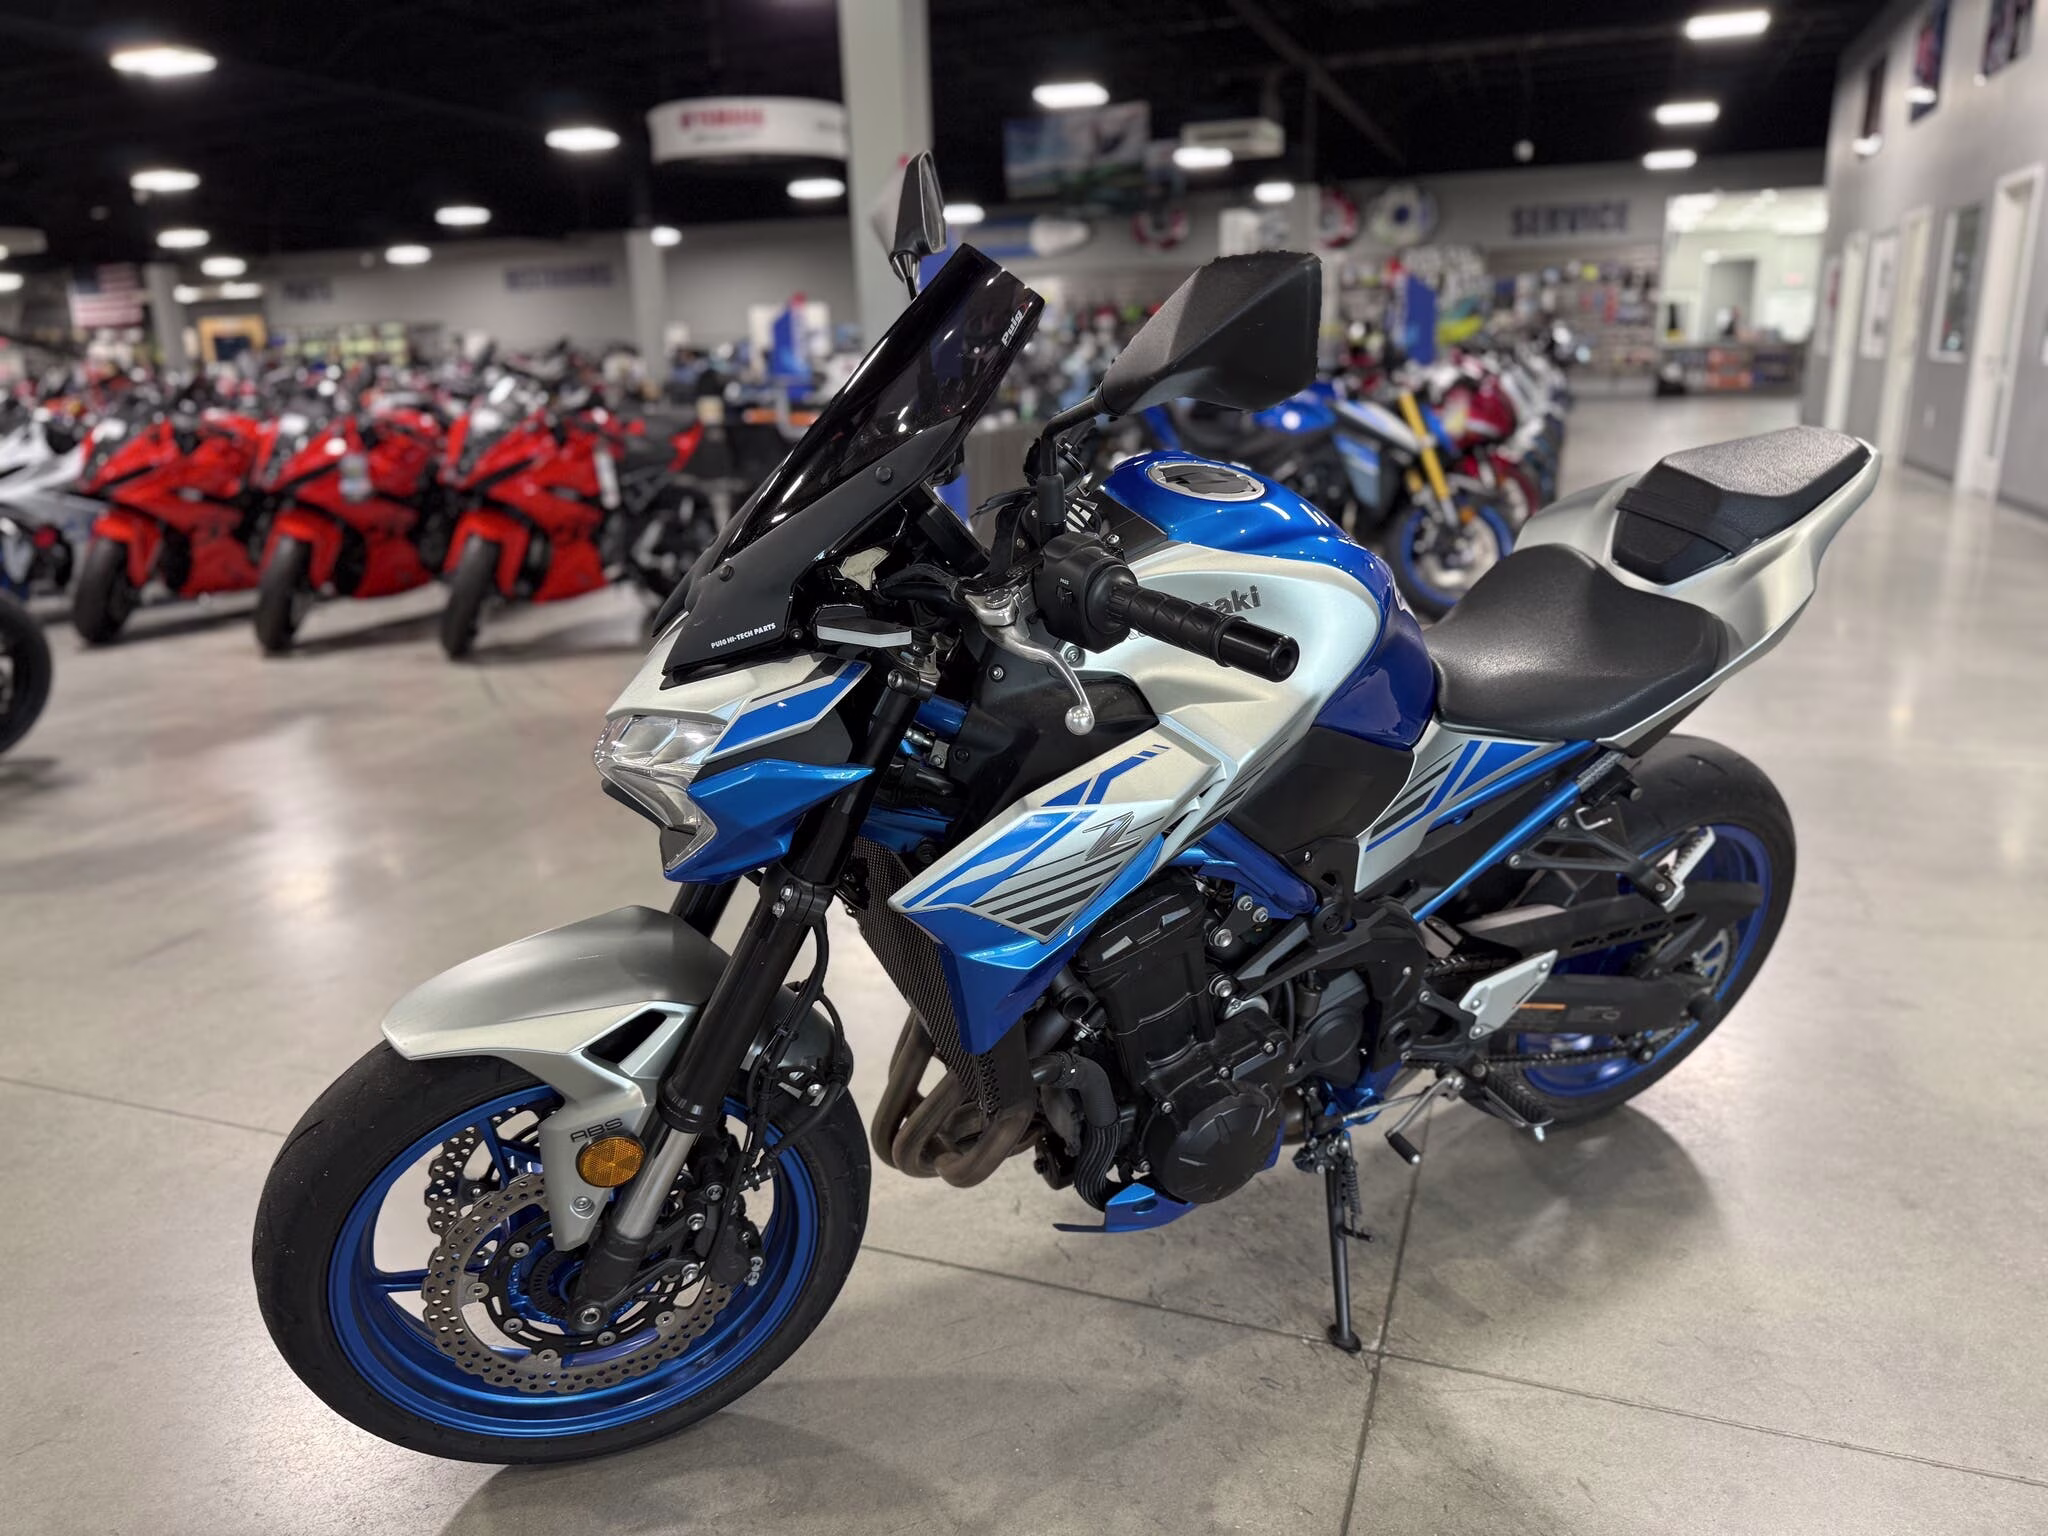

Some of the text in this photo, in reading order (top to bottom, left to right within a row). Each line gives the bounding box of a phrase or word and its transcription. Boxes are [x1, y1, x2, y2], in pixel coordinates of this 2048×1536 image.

[727, 630, 753, 644] HI-TECH
[753, 622, 776, 635] PARTS
[570, 1118, 622, 1143] ABS
